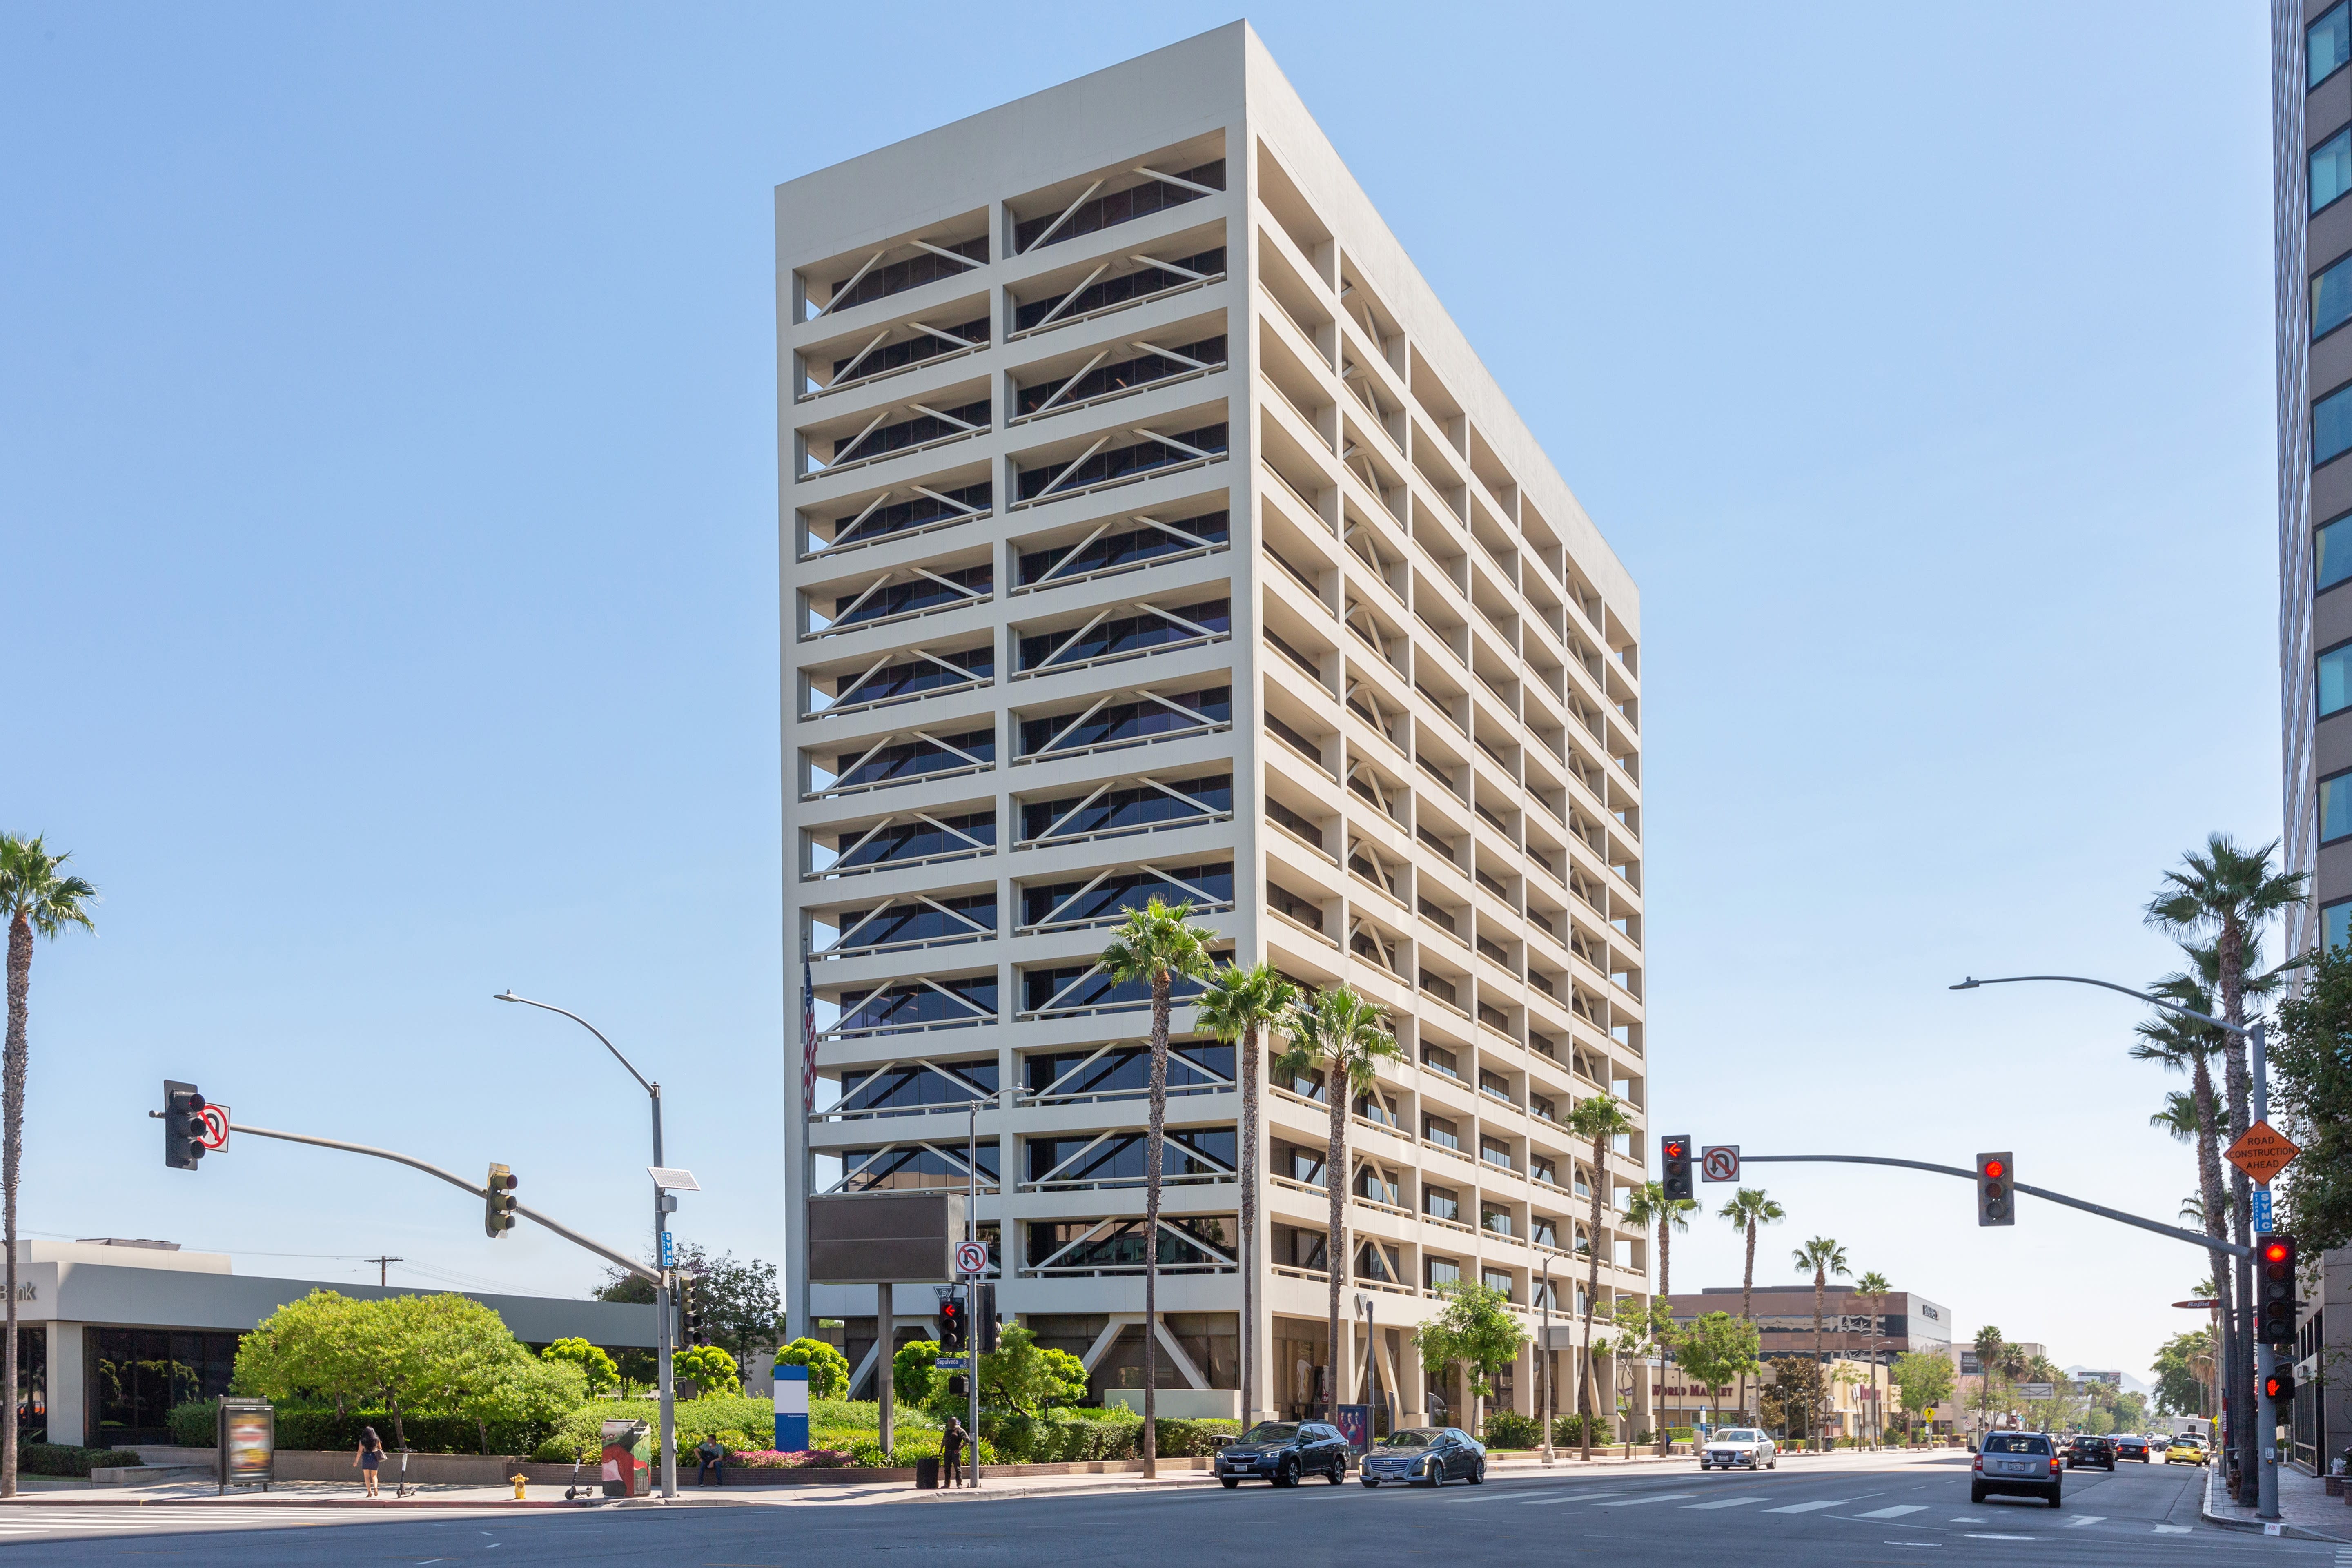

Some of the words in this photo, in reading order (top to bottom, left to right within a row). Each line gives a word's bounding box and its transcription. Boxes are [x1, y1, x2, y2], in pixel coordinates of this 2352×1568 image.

[2247, 1137, 2274, 1145] ROAD
[2229, 1147, 2295, 1158] CONSTRUCTION
[2246, 1160, 2279, 1169] AHEAD
[2261, 1193, 2270, 1229] SYNC
[0, 1282, 36, 1301] Bnk
[1689, 1385, 1733, 1396] MAET
